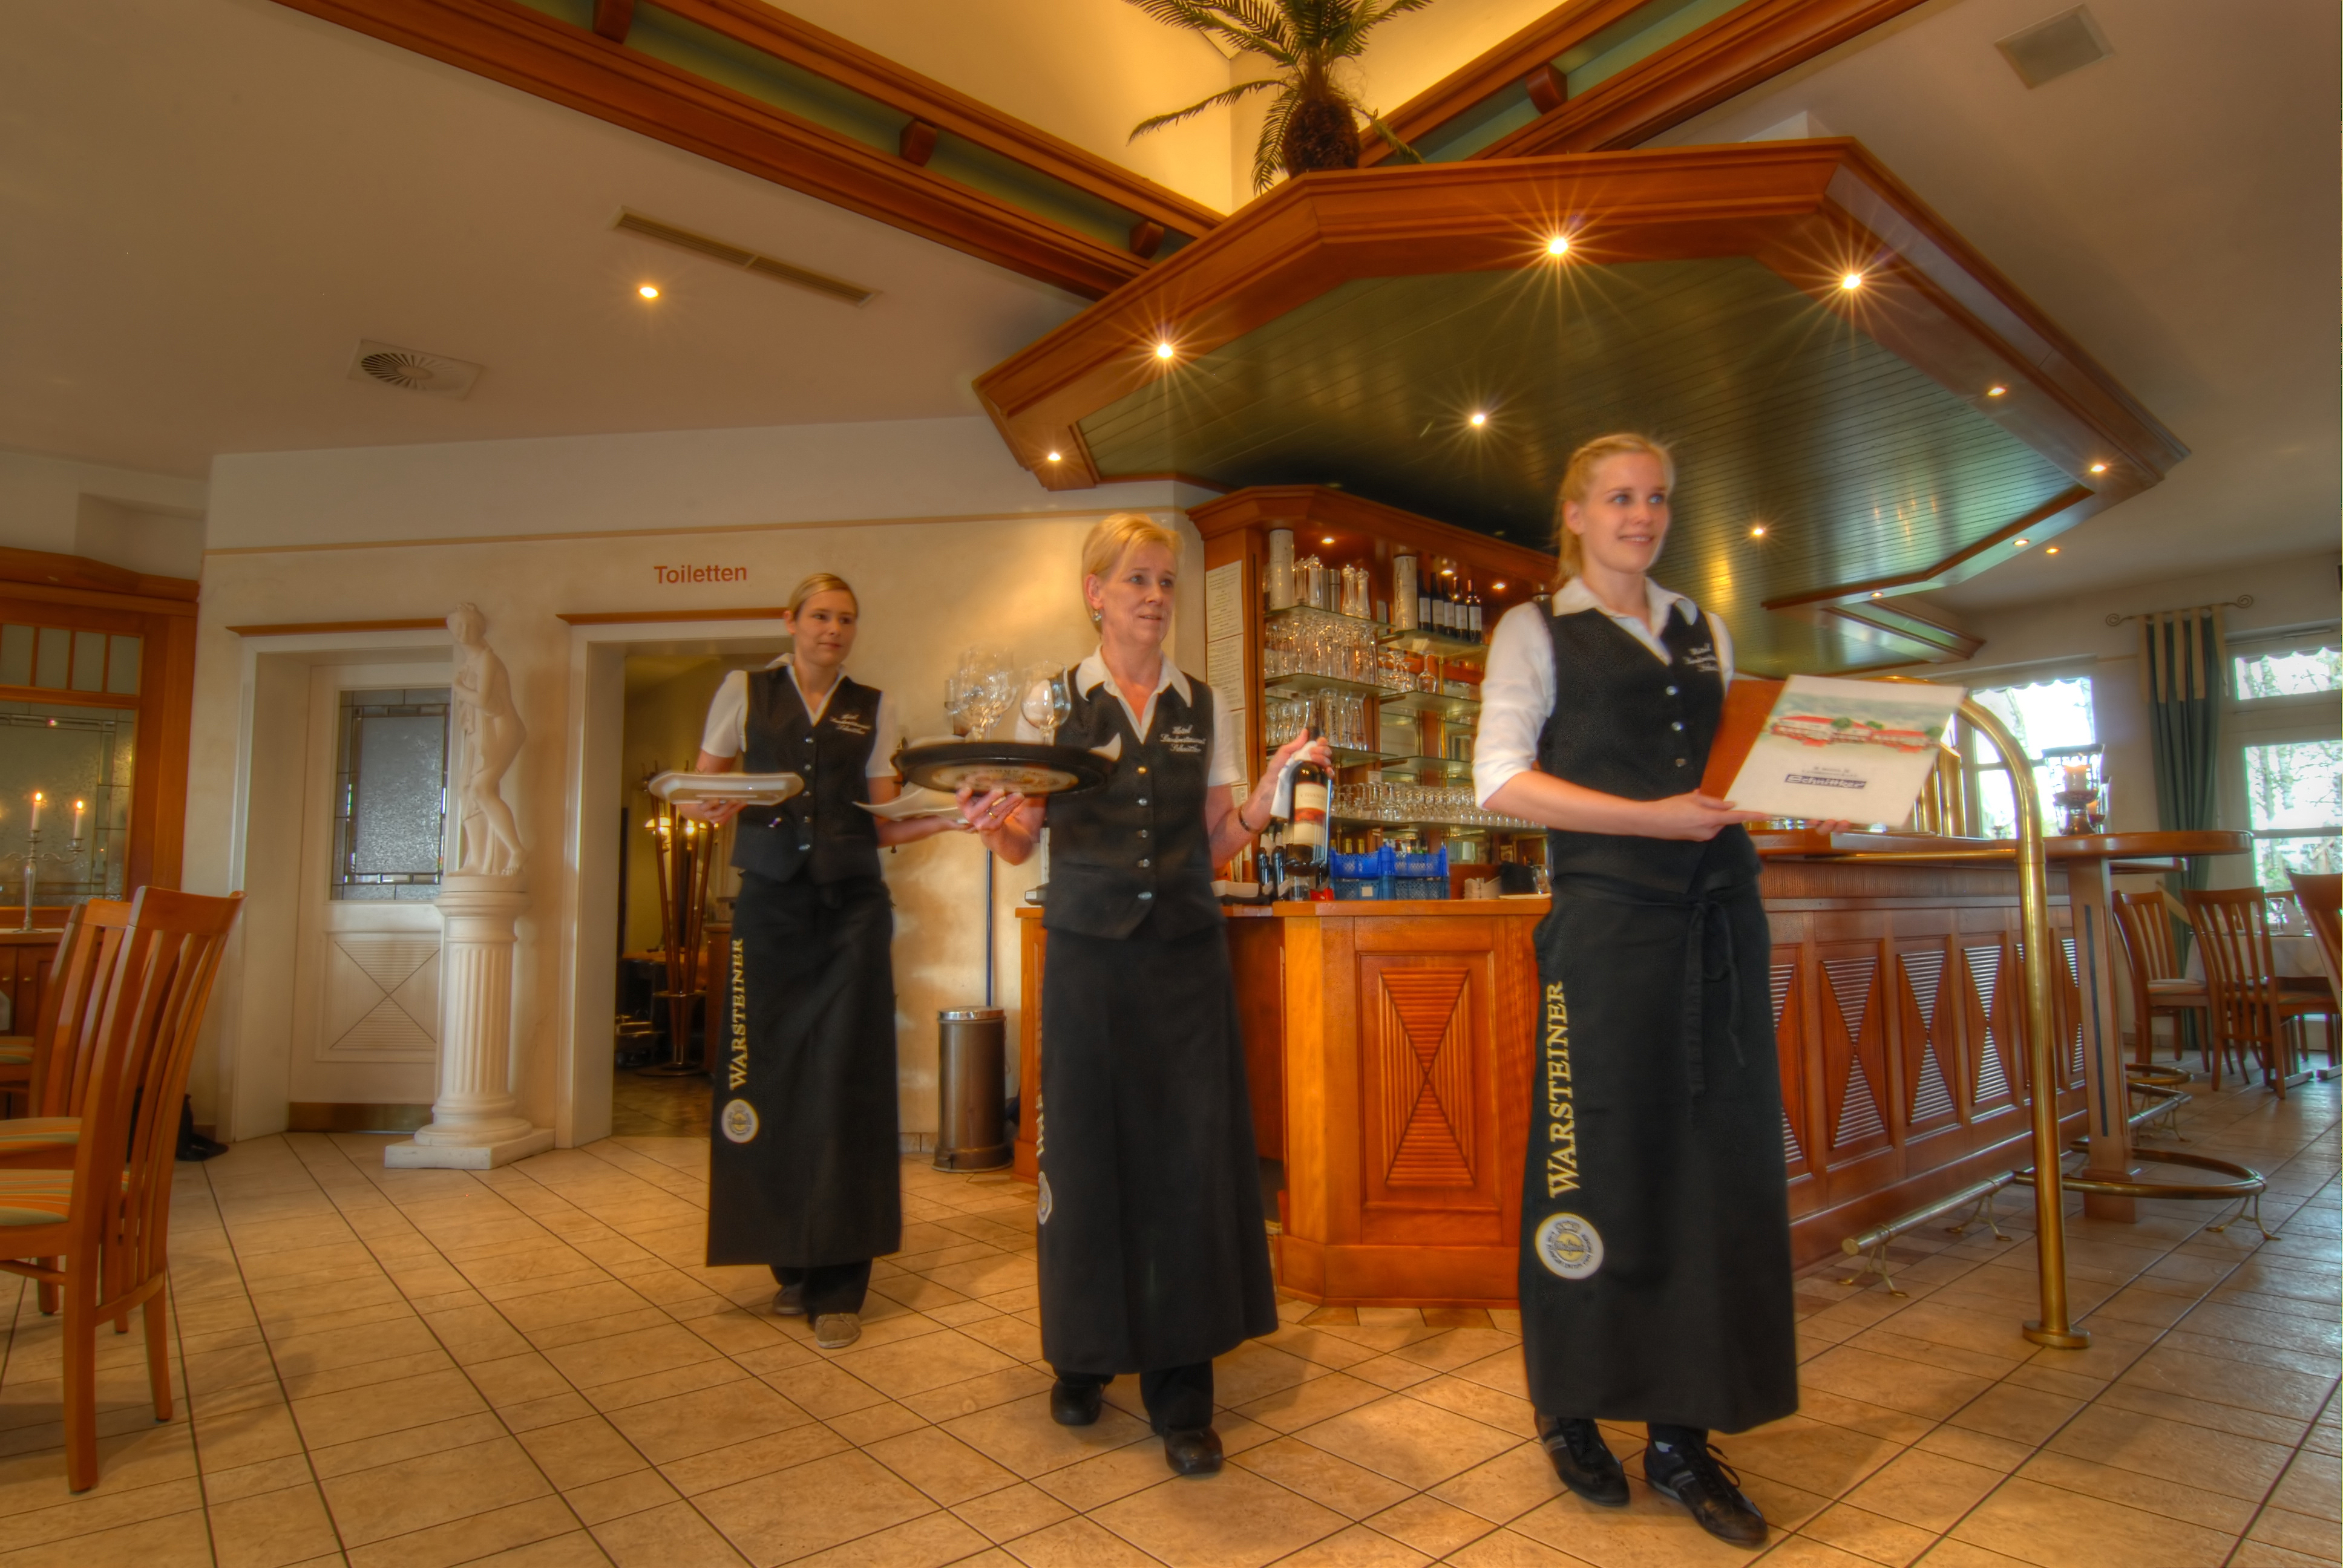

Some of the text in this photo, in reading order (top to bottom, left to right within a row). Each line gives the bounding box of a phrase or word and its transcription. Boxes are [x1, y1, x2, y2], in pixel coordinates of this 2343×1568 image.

[654, 565, 747, 584] Toiletten
[729, 938, 748, 1091] WARSTEINER
[1547, 981, 1581, 1199] WARSTEINER
